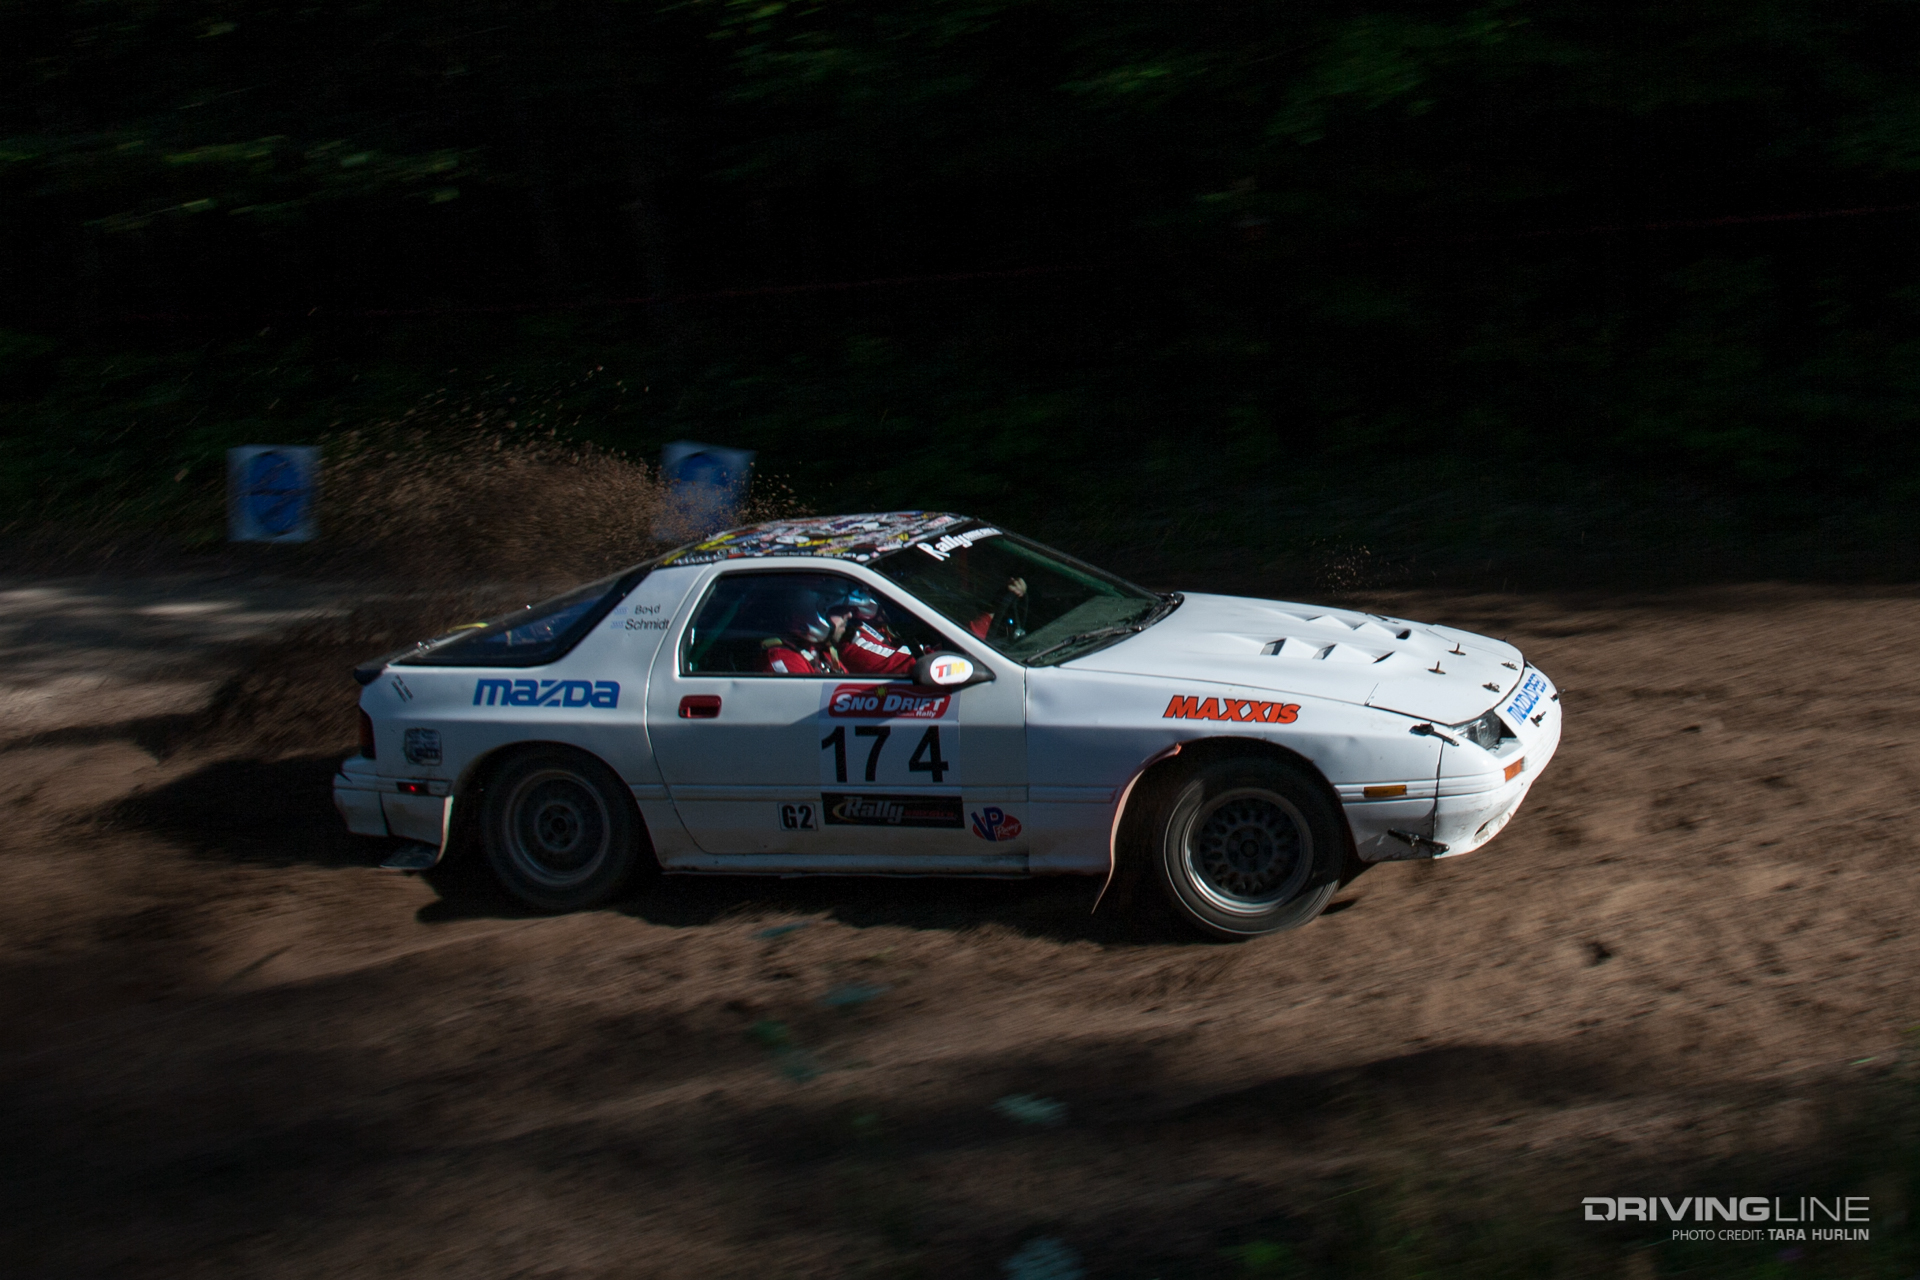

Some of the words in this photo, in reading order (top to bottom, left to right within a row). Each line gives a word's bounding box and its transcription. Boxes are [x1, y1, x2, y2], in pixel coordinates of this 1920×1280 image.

[634, 604, 661, 616] Boyd
[625, 618, 670, 630] Schmidt
[936, 661, 966, 678] TIM
[833, 693, 879, 713] SNO
[882, 693, 945, 713] DRIFT
[1162, 694, 1301, 724] MAXXIS
[915, 709, 936, 718] Rally
[843, 795, 905, 824] Rally
[971, 807, 1004, 841] VP
[996, 821, 1021, 838] Racing
